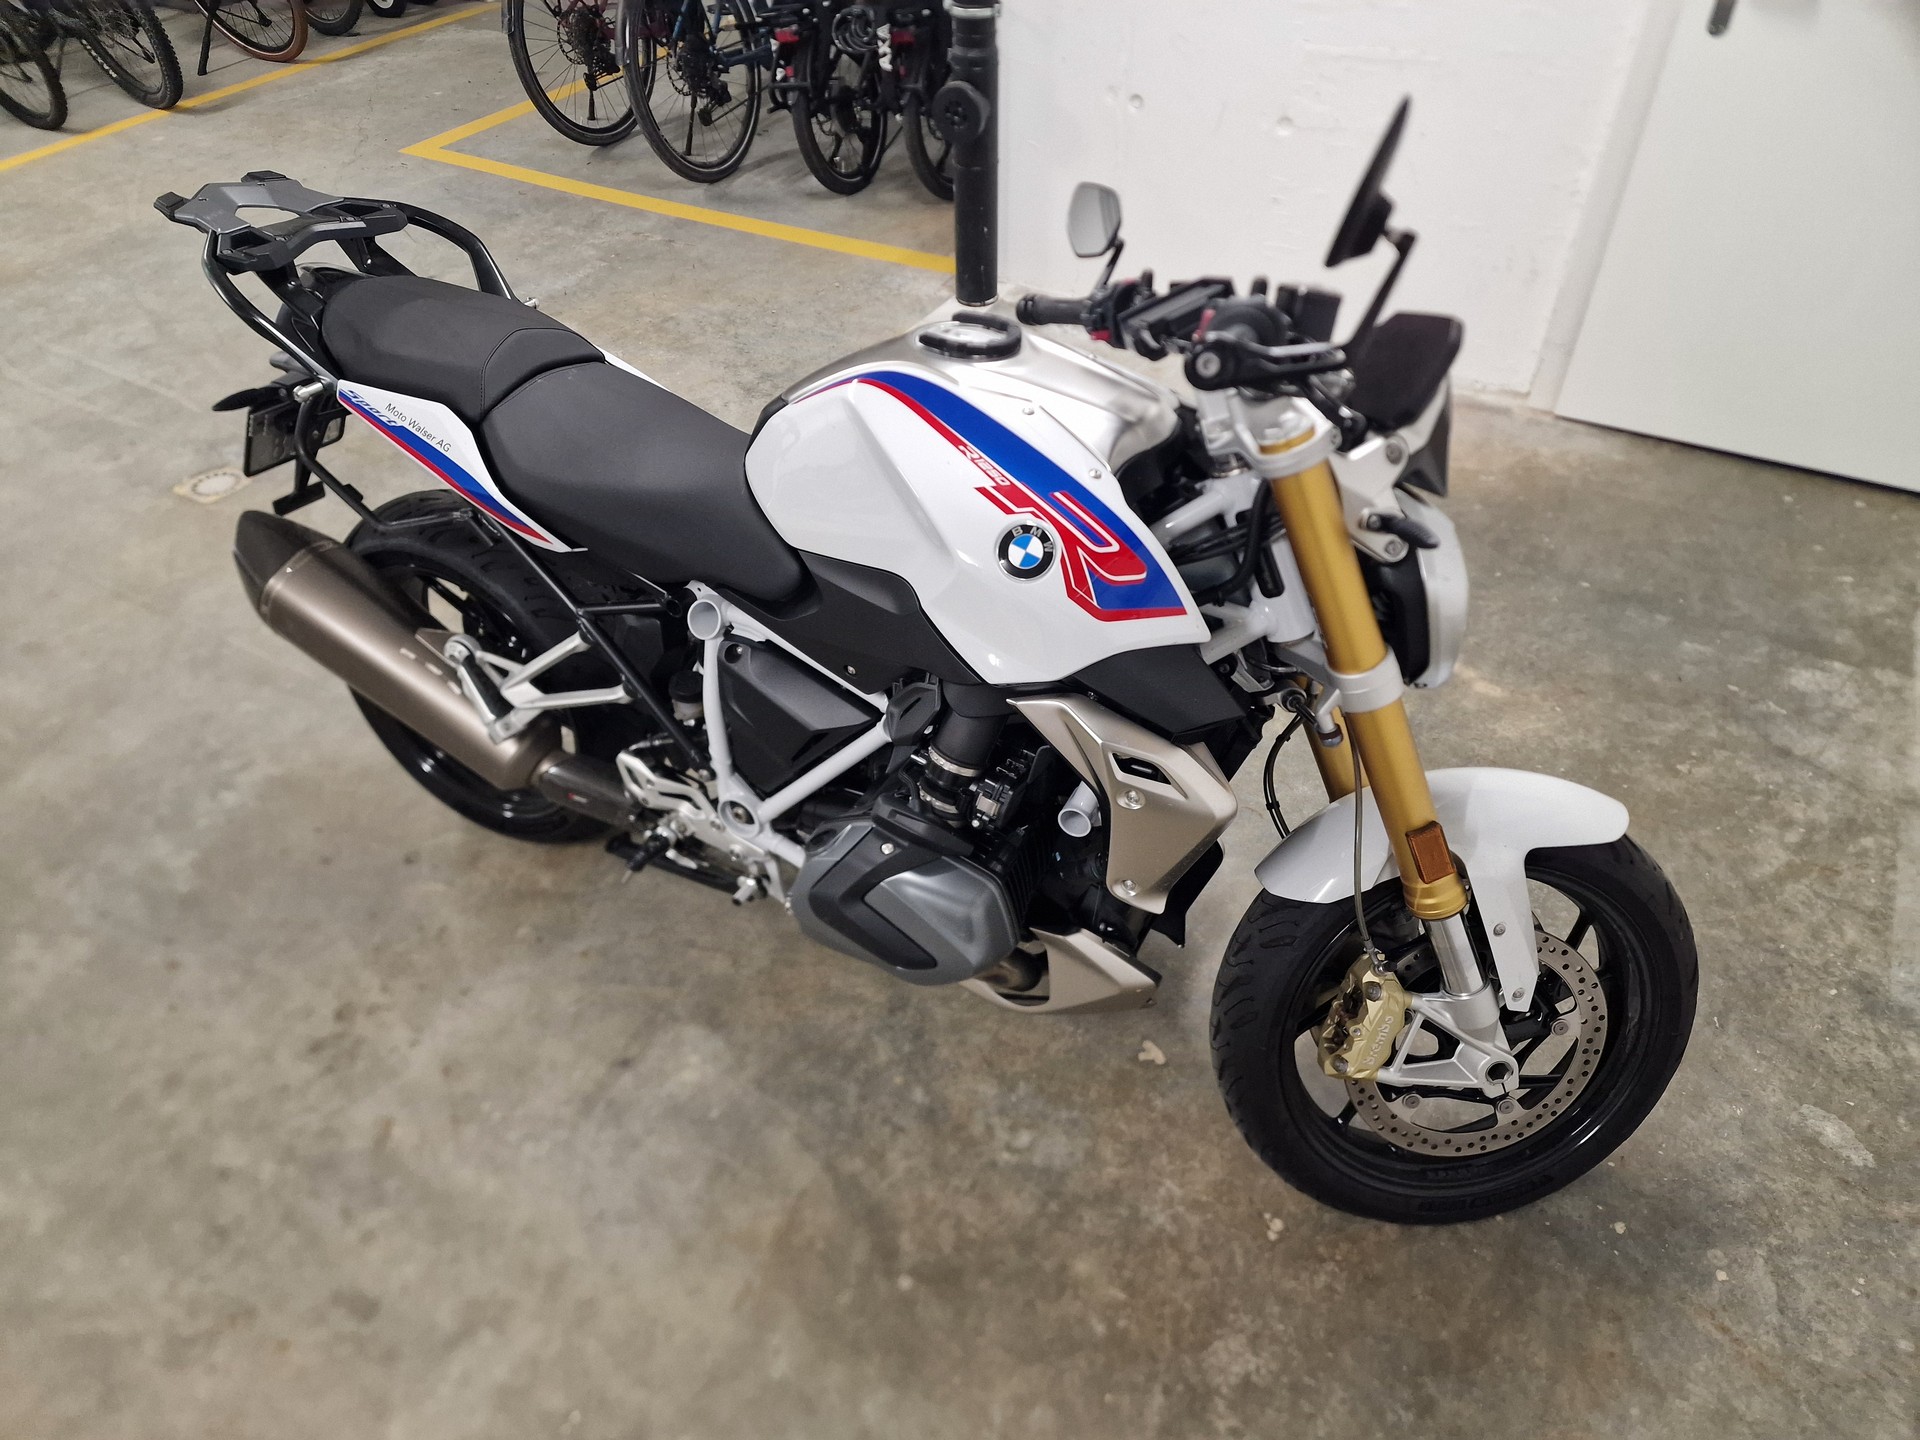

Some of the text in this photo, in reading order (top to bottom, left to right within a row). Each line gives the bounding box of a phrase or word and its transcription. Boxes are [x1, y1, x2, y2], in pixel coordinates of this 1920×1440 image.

[342, 389, 398, 425] Sport
[385, 403, 452, 452] Moto Walser AG
[1012, 525, 1054, 552] BMW
